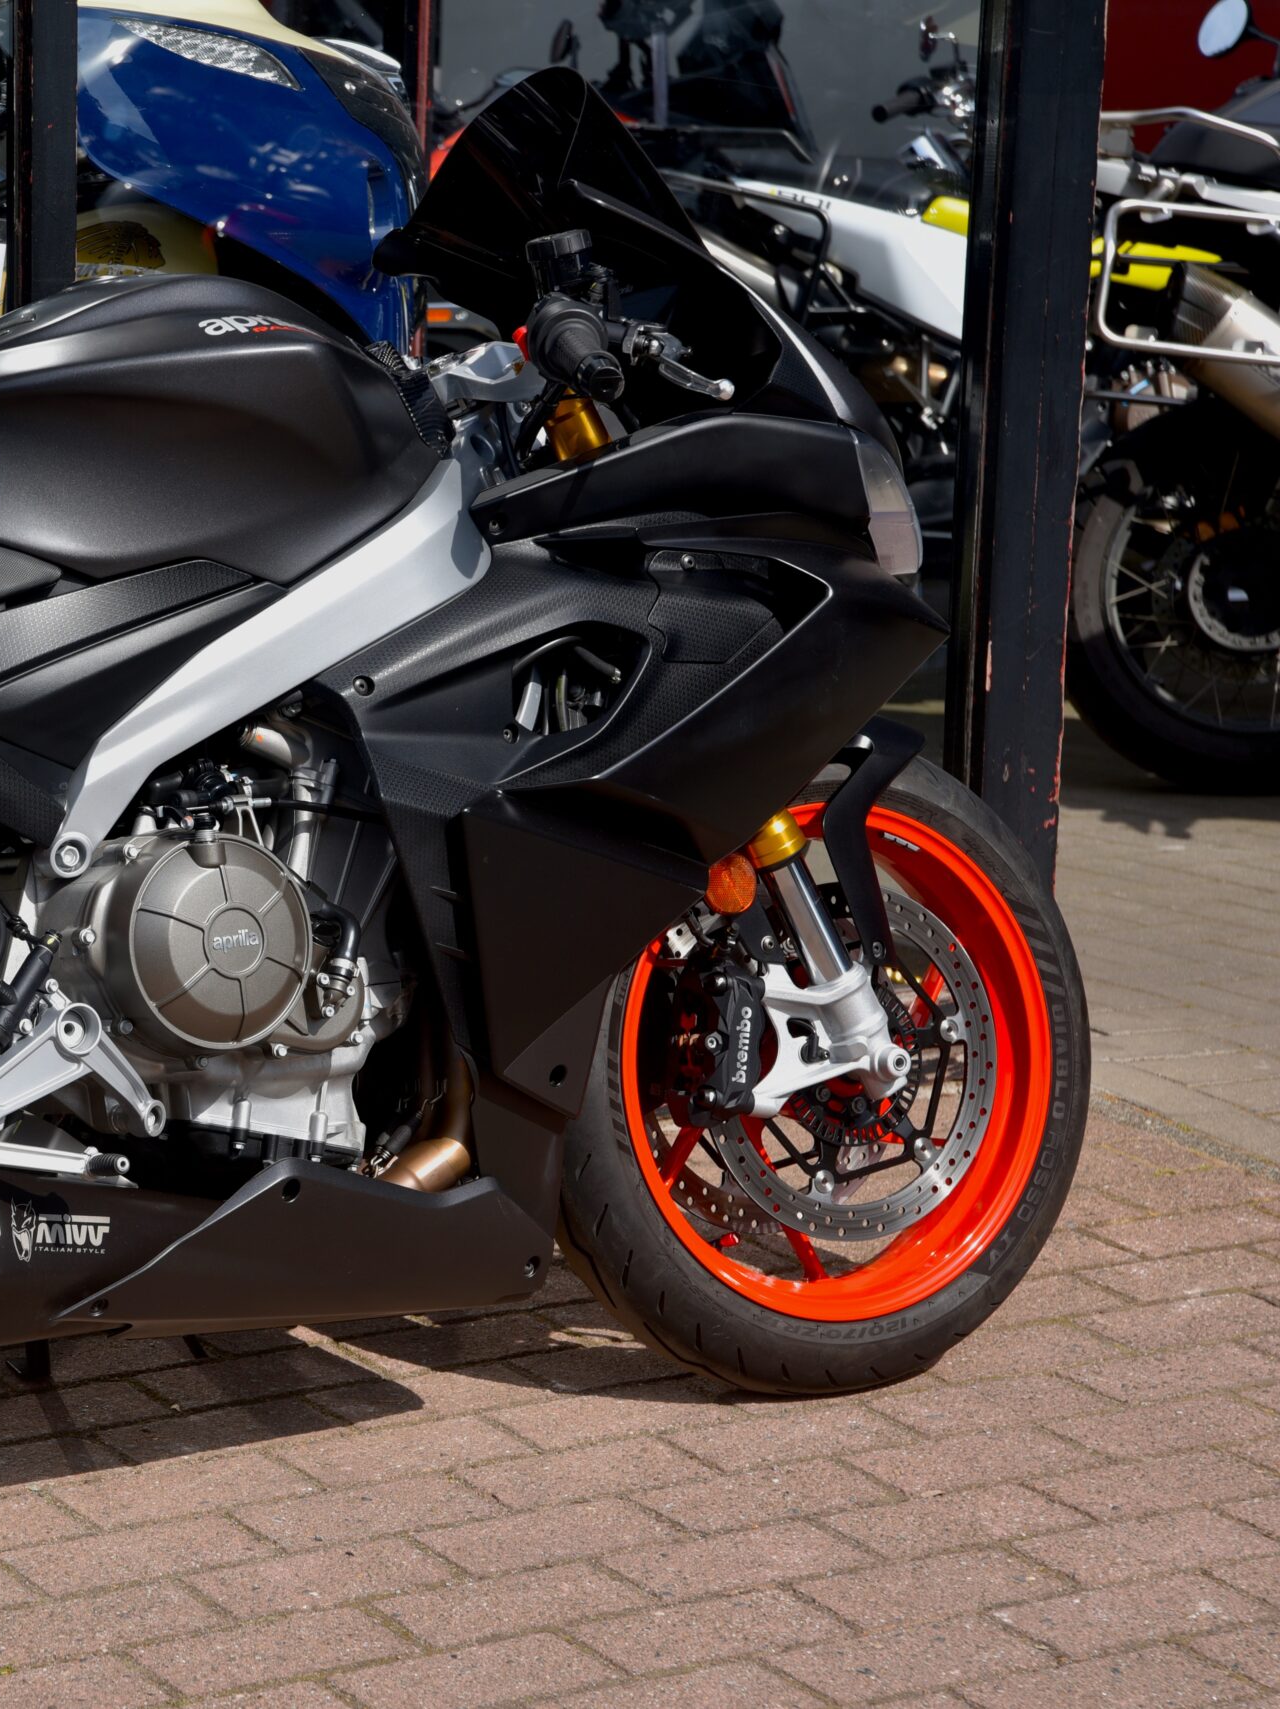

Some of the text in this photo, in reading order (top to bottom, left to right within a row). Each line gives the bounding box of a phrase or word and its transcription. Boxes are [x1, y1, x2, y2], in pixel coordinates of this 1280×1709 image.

[213, 928, 259, 953] aprilia
[731, 1006, 752, 1084] brembo
[984, 1001, 1069, 1270] DIABLO ROSSO IV
[825, 1316, 908, 1340] 120/70
